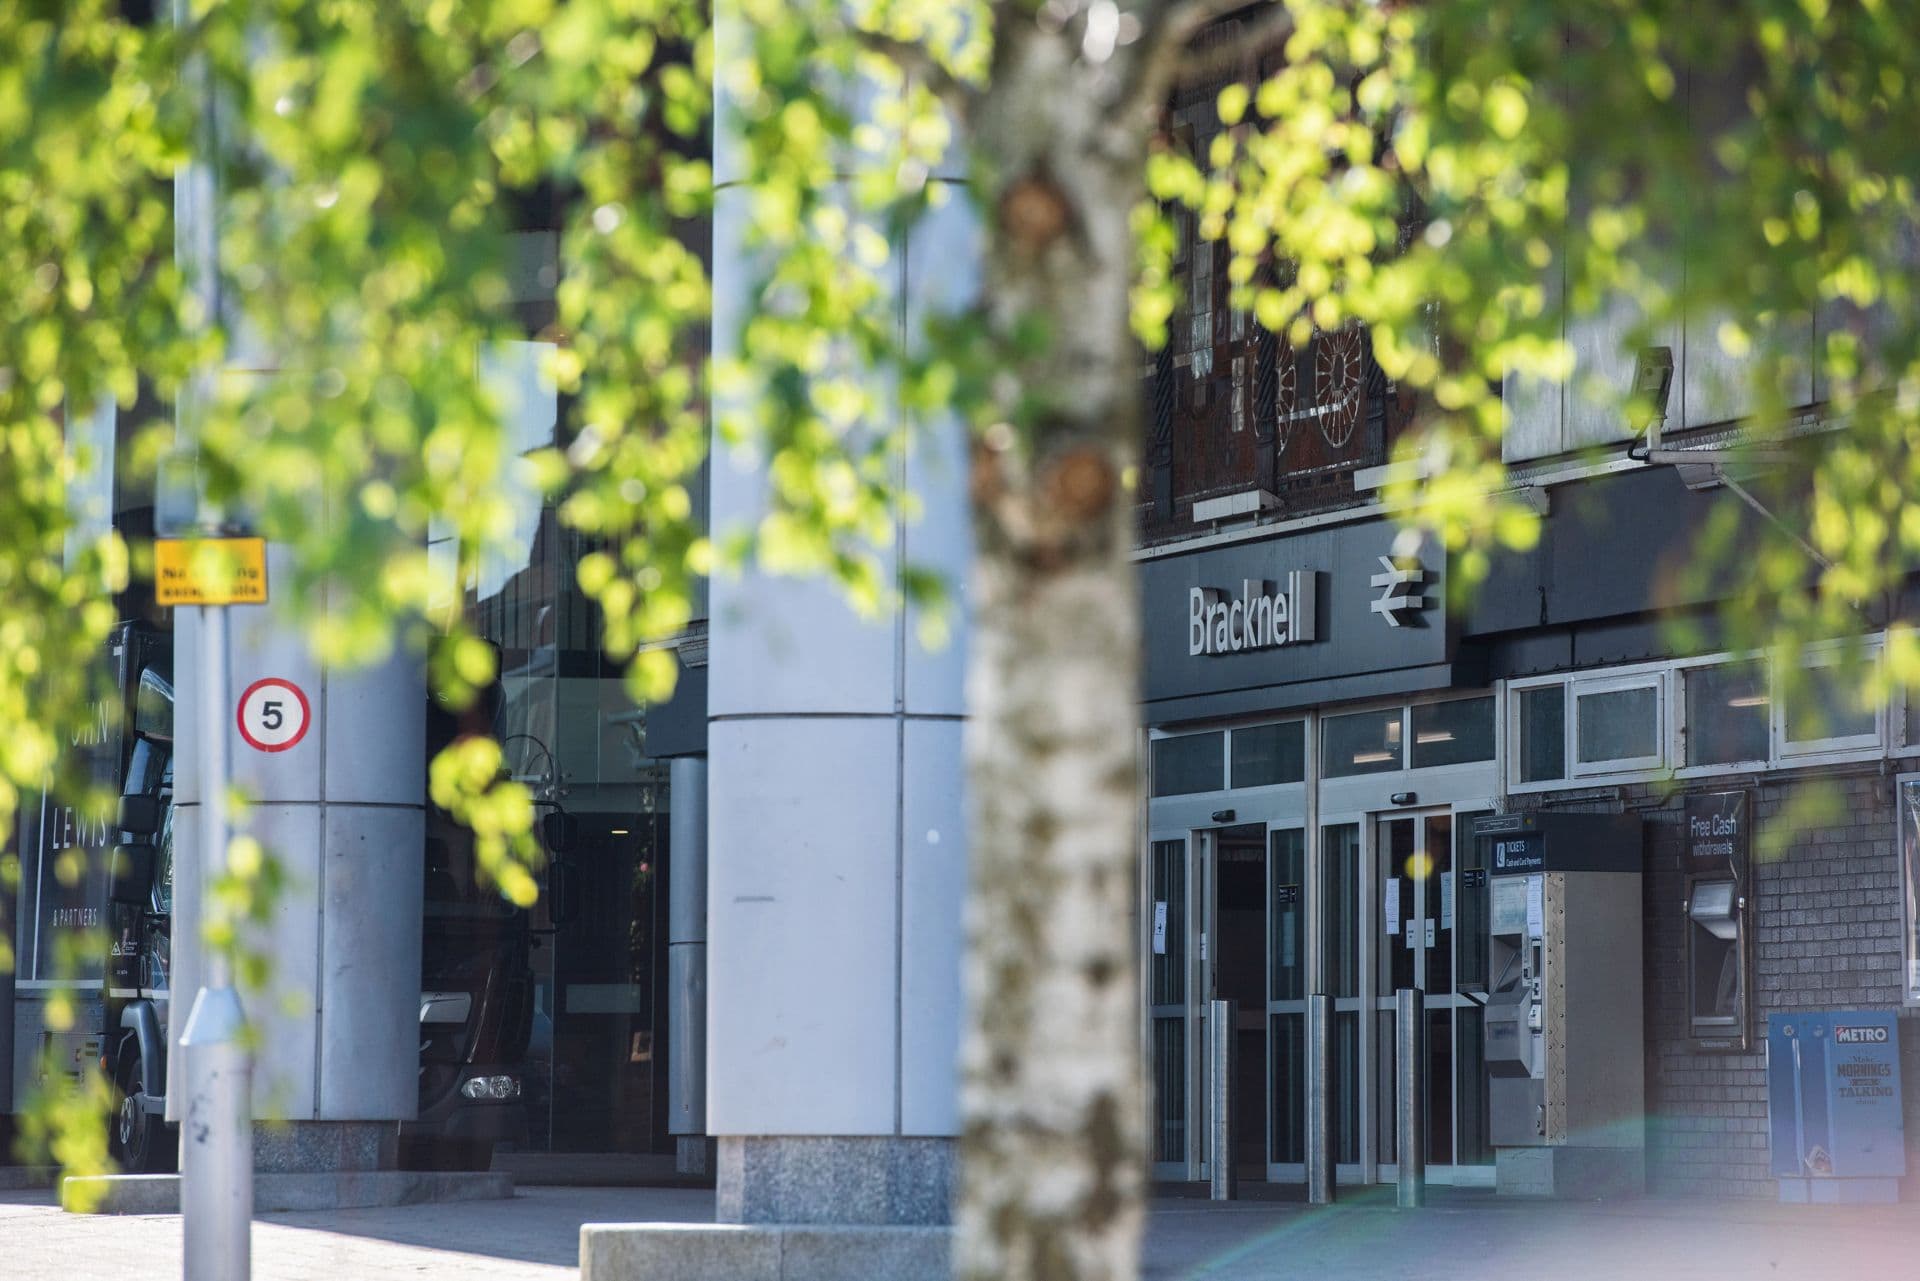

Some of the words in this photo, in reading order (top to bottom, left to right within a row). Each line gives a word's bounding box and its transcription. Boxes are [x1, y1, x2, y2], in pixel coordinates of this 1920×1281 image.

[1189, 570, 1307, 656] Bracknell
[262, 701, 283, 730] 5
[53, 807, 106, 849] LEWIS
[1691, 816, 1710, 837] Free
[1712, 813, 1736, 836] Cash
[1506, 840, 1525, 852] TICKETS
[1692, 839, 1733, 857] withdrawals
[60, 907, 97, 927] PARTNERS
[1839, 1028, 1887, 1042] METRO
[1838, 1086, 1893, 1098] TALKING
